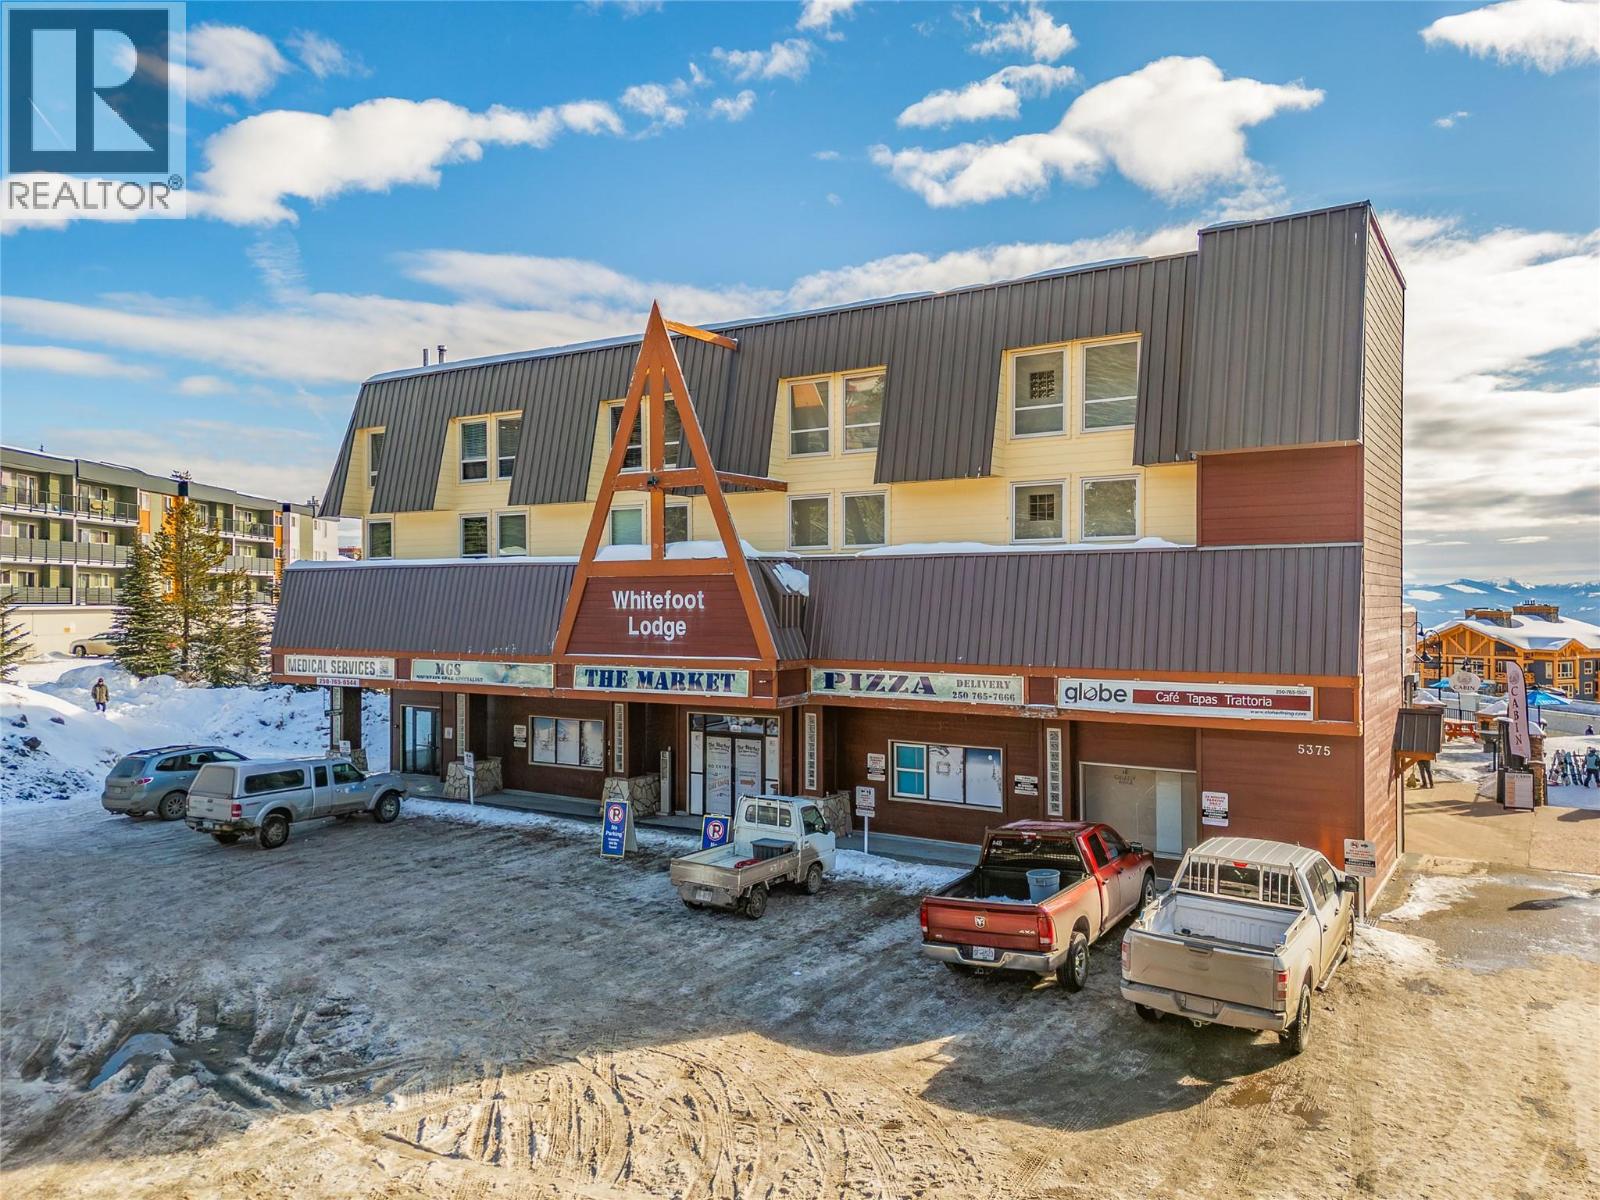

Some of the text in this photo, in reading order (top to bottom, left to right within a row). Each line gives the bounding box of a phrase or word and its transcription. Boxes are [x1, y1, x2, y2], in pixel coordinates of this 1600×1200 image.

[611, 590, 705, 610] Whitefoot
[628, 616, 687, 641] Lodge
[287, 658, 376, 676] MEDICAL SERVICES
[434, 662, 462, 676] MGS
[584, 669, 736, 693] THE MARKET
[823, 671, 937, 696] PIZZA
[956, 679, 1011, 690] DELIVERY
[952, 691, 1016, 702] 250 765-7666
[1064, 682, 1128, 704] globe
[1155, 691, 1273, 707] Café Tapas Trattoria
[1511, 686, 1522, 745] CABIN
[1297, 744, 1331, 756] 5375
